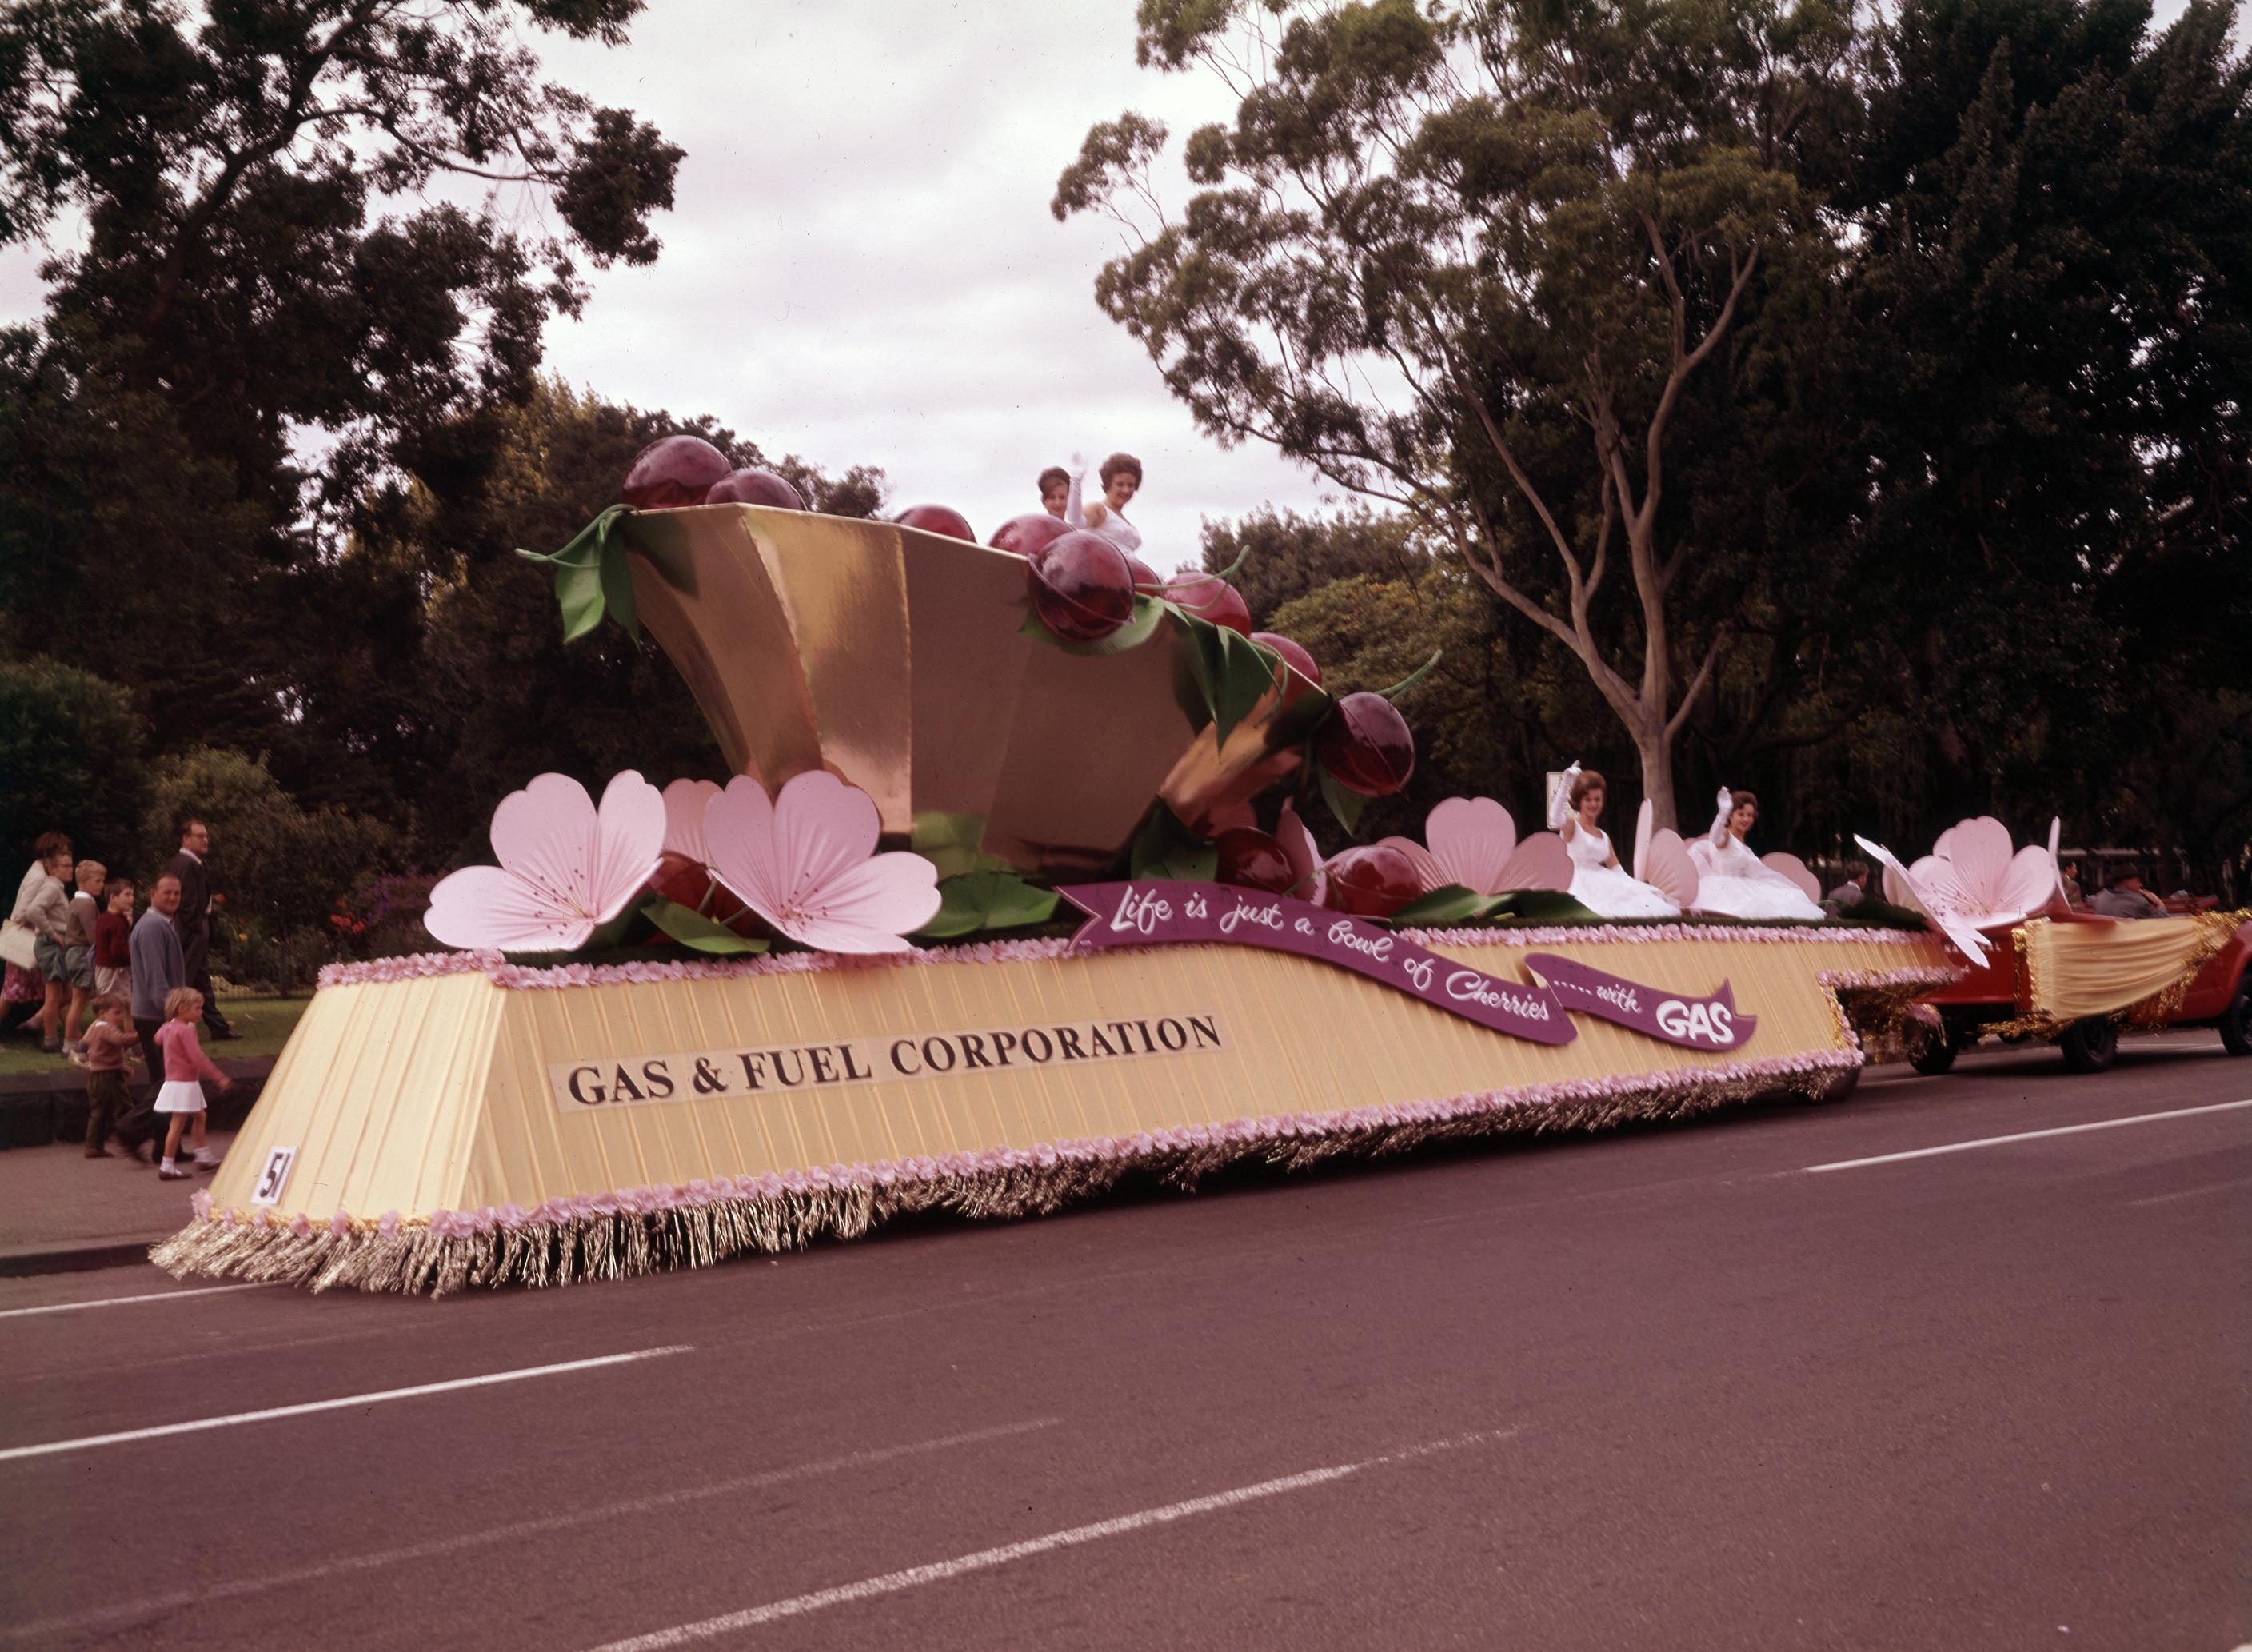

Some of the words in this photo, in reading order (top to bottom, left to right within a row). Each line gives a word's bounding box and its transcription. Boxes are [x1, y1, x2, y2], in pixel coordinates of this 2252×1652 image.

[1110, 884, 1173, 935] Life
[1184, 892, 1208, 918] is
[1220, 895, 1284, 933] just
[1294, 917, 1316, 936] a
[1404, 958, 1435, 992] of
[1445, 970, 1550, 1021] Cherries
[568, 1060, 675, 1105] GAS
[693, 1057, 728, 1094] &
[737, 1044, 873, 1089] FUEL
[890, 1014, 1222, 1076] CORPORATION
[1596, 984, 1642, 1013] with
[1655, 1000, 1735, 1045] GAS
